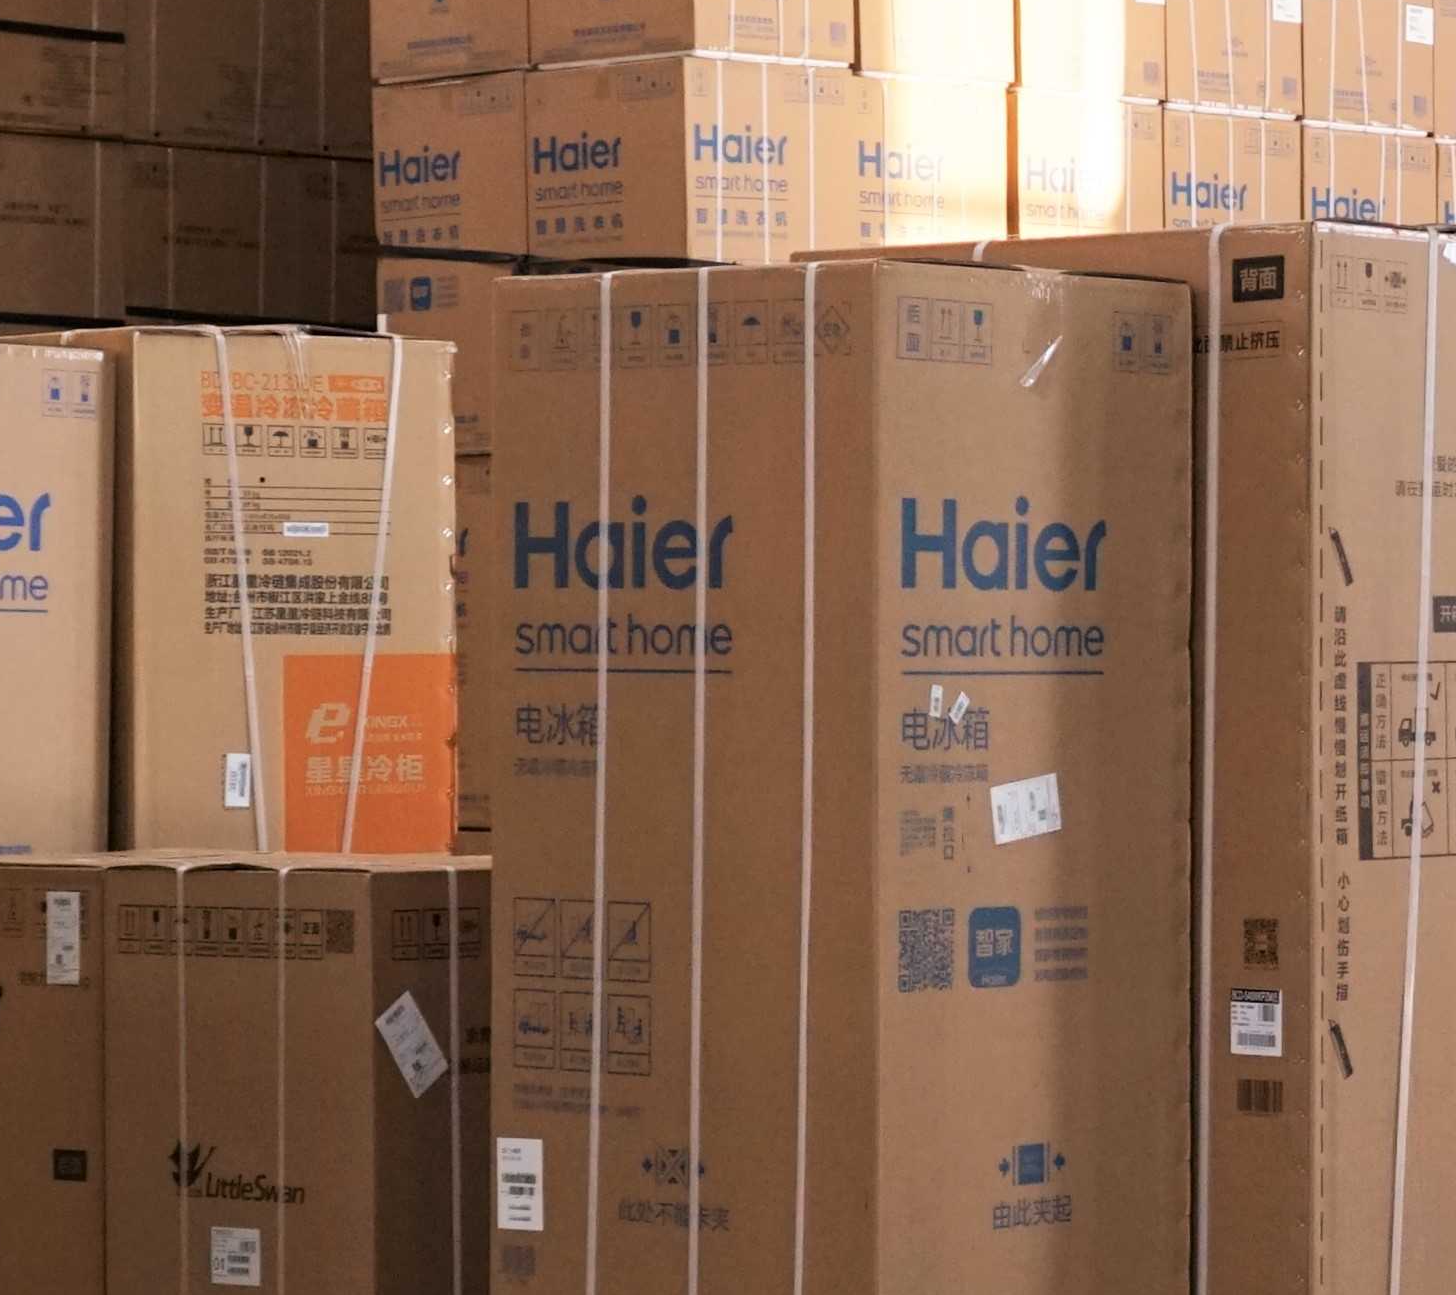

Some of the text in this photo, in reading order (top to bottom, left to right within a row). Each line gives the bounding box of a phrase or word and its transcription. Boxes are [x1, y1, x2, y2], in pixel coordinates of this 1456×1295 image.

[533, 131, 621, 174] Haier
[694, 124, 787, 165] Haier
[379, 146, 460, 186] Haier
[1171, 171, 1247, 211] Haier
[1240, 266, 1277, 292] 背面
[513, 494, 734, 591] Haier
[900, 495, 1107, 591] Haier
[515, 614, 733, 656] smart home
[901, 617, 1104, 658] smart home
[515, 705, 602, 747] 电冰箱
[900, 706, 989, 751] 电冰箱
[305, 754, 423, 784] 星星冷柜
[976, 929, 1013, 956] 智家
[204, 1173, 305, 1205] LittleSwan
